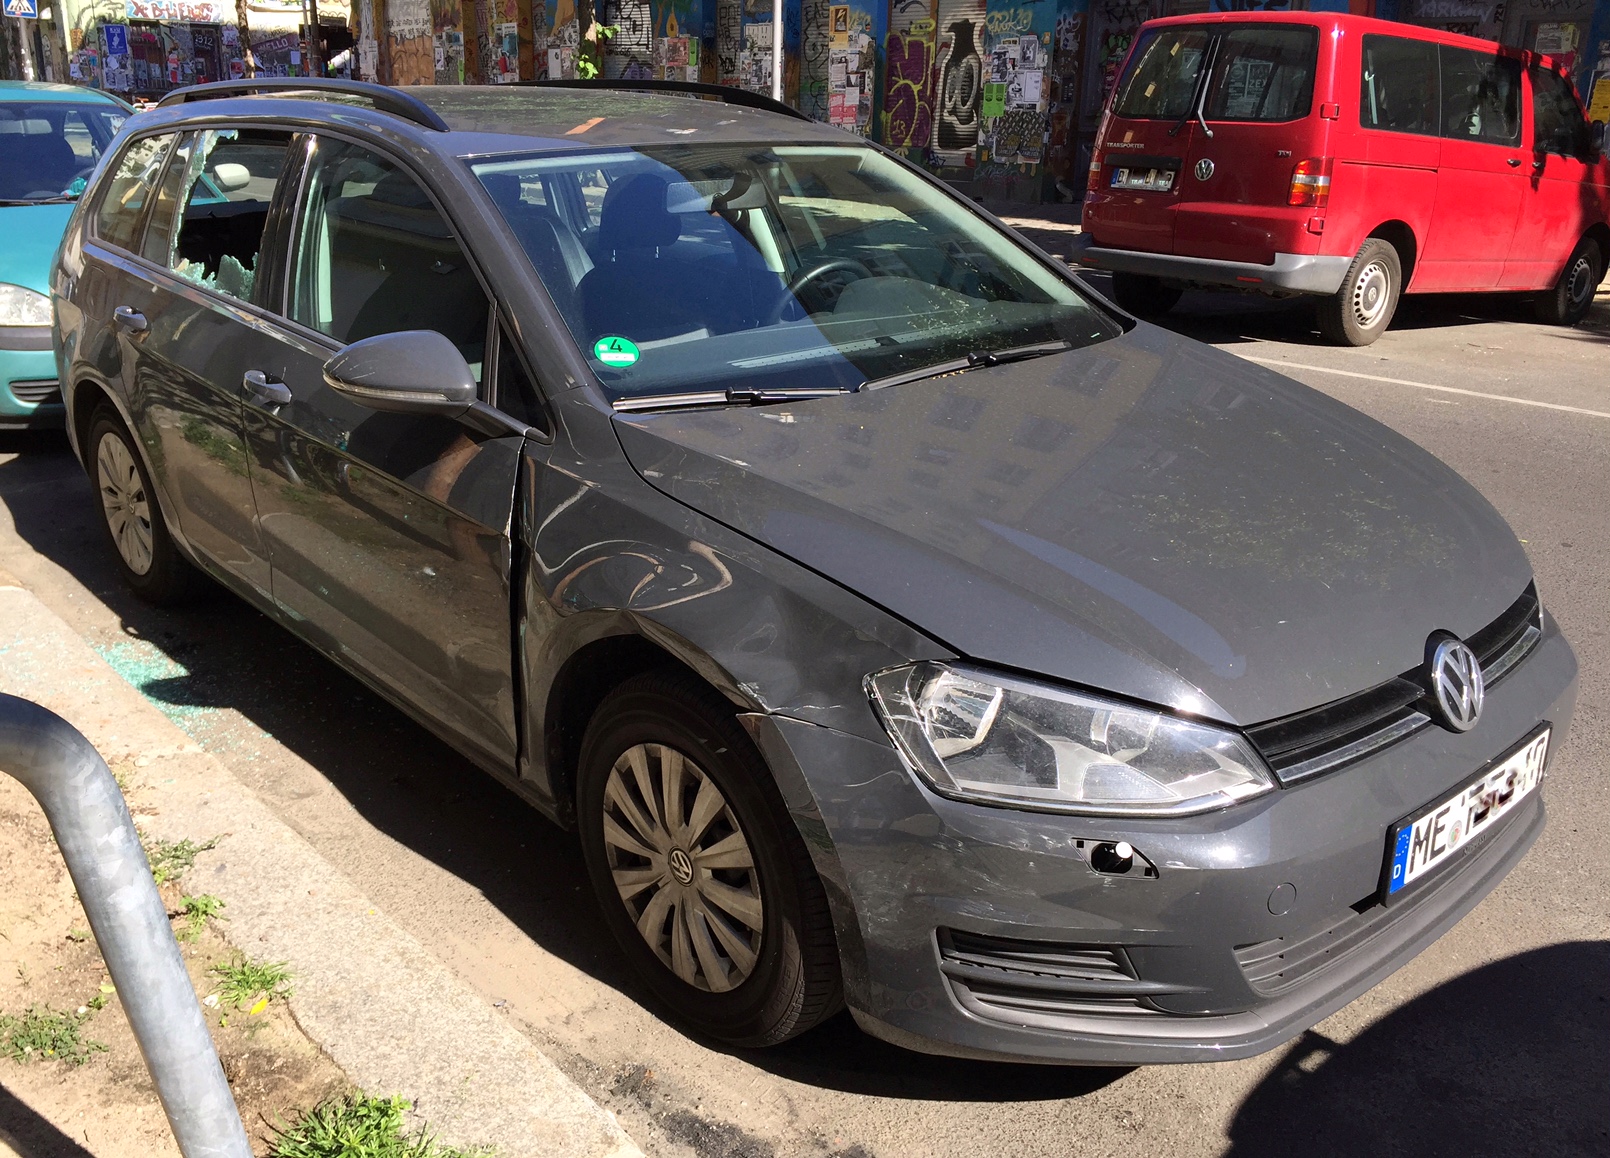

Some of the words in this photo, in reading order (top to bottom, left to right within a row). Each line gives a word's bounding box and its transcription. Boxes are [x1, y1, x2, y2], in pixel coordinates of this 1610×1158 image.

[610, 339, 623, 352] 4
[1409, 806, 1451, 875] ME
[1393, 864, 1402, 879] D
